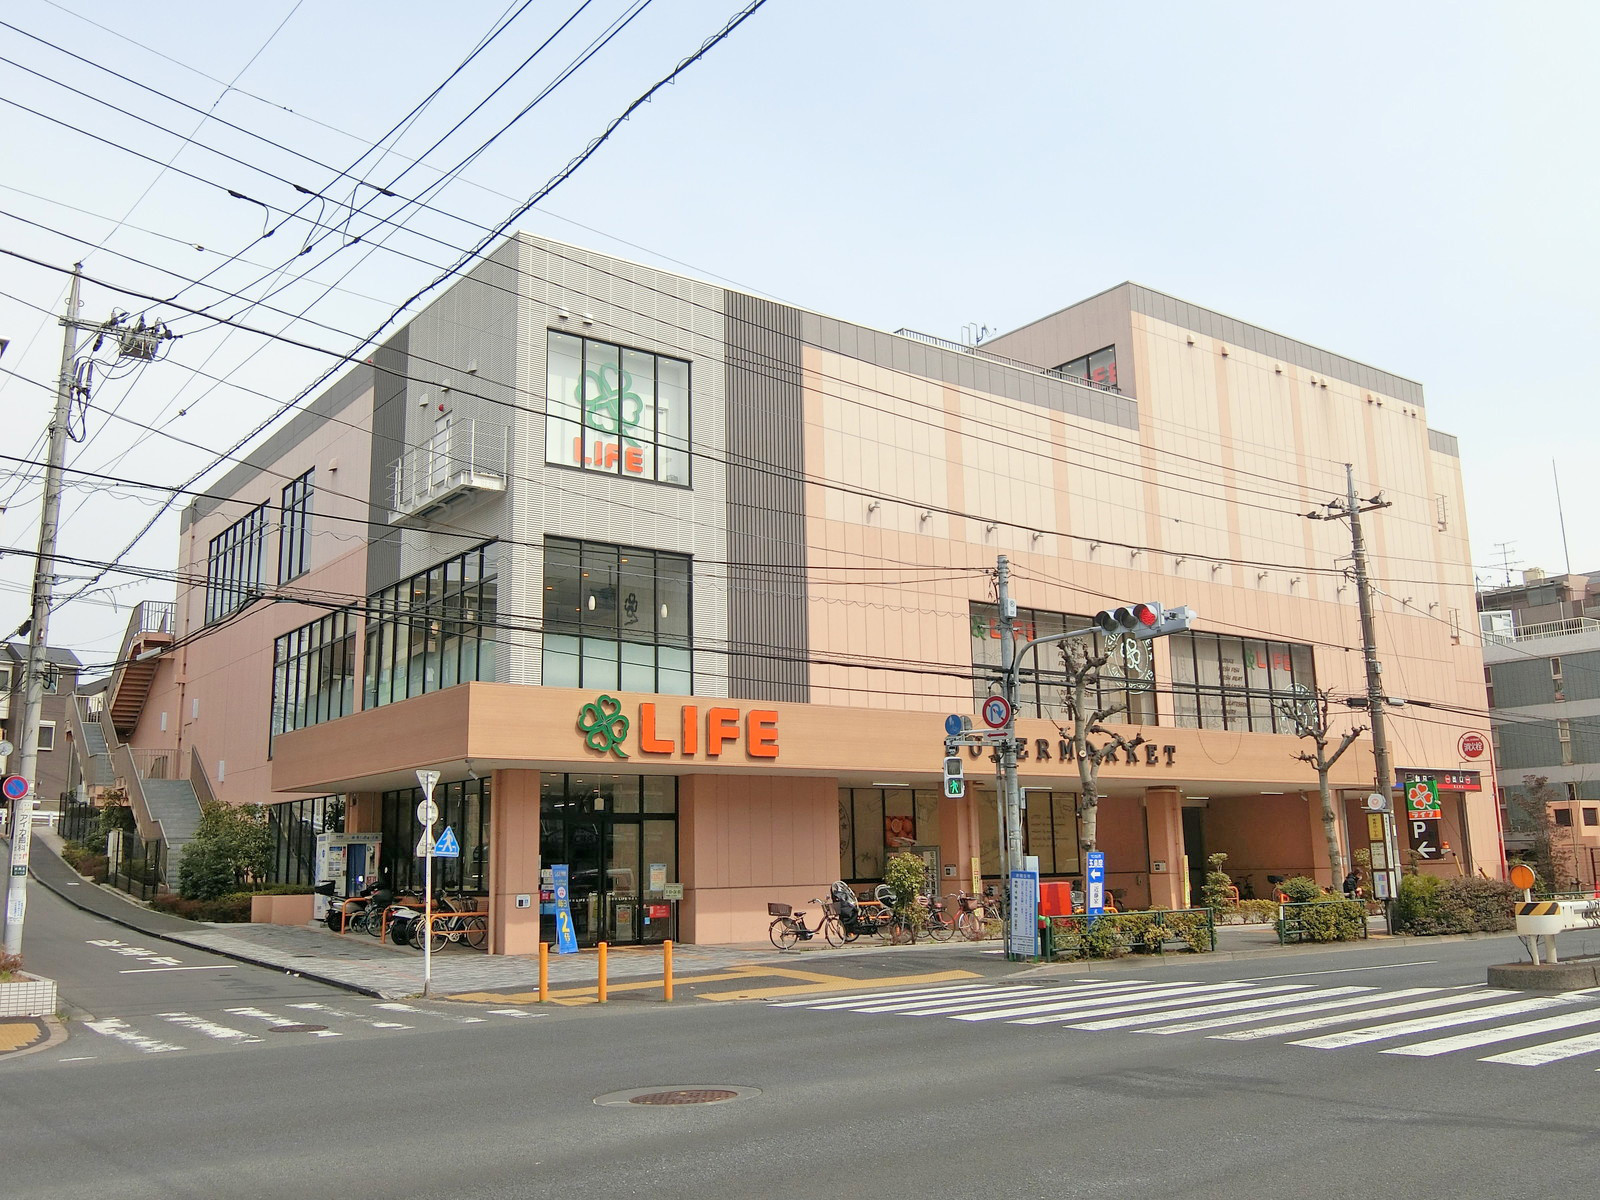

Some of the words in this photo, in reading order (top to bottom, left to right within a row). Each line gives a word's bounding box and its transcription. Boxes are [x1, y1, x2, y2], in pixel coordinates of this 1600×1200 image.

[573, 437, 644, 474] LIFE
[1255, 650, 1292, 672] LFE
[639, 702, 780, 758] LIFE
[945, 734, 1176, 766] UERMRKET
[1411, 810, 1435, 819] ライフ
[1413, 821, 1426, 839] P
